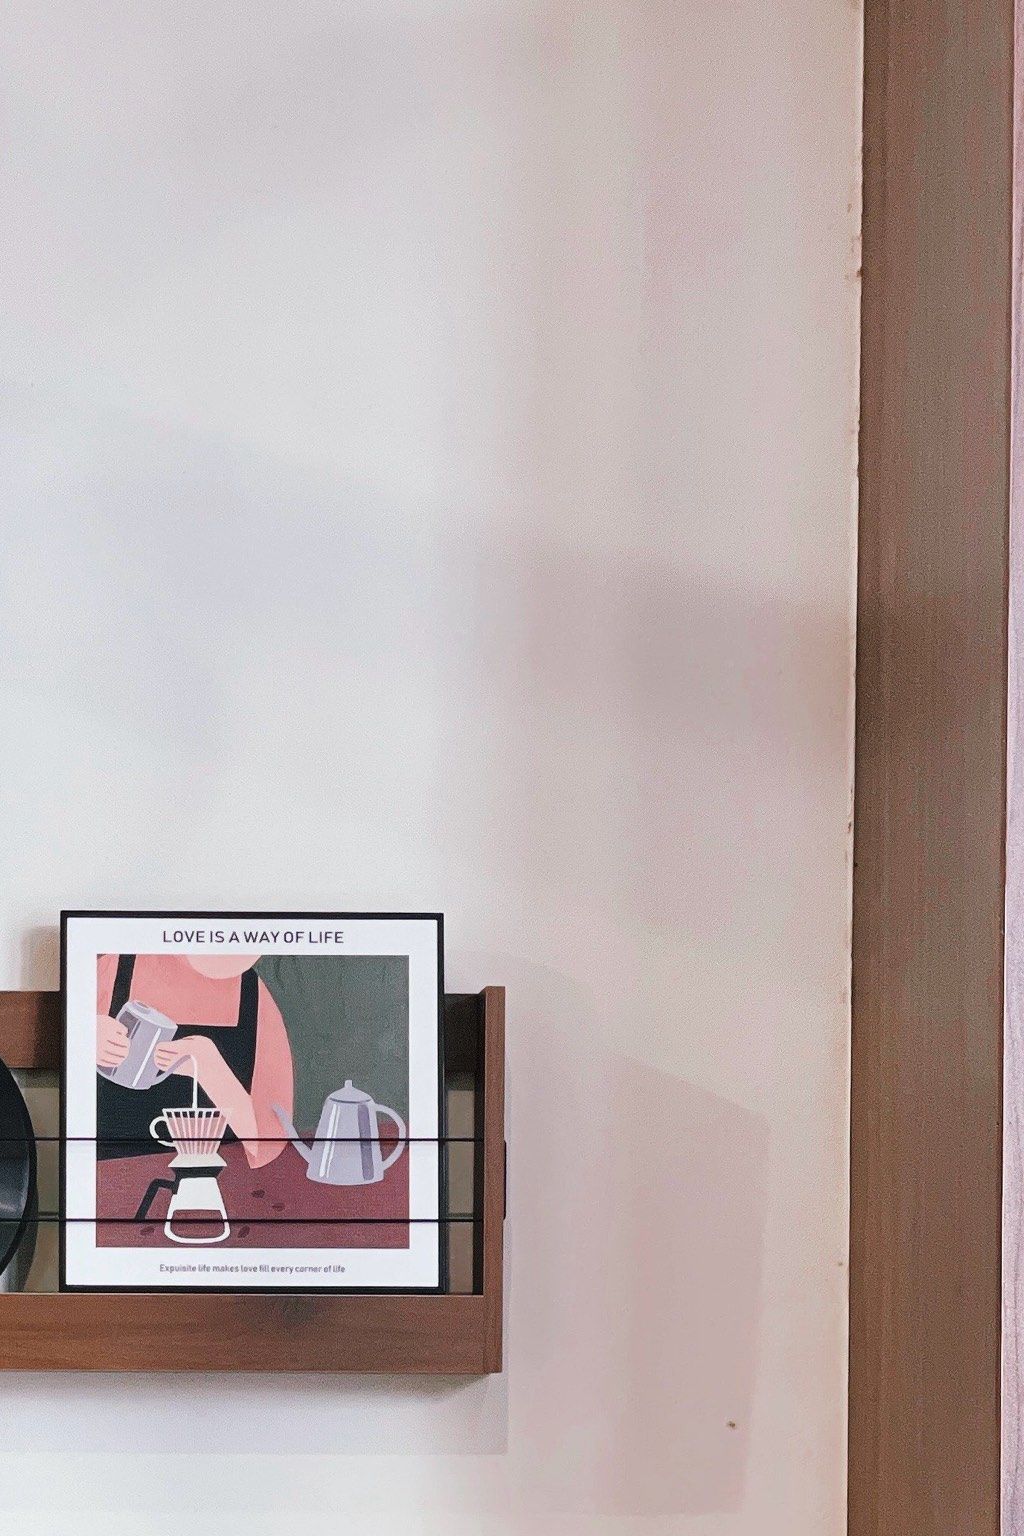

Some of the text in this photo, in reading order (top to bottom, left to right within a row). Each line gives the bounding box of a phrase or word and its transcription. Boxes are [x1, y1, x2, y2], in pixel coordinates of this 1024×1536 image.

[163, 931, 344, 944] LOVE IS A WAY OF LIFE
[198, 1264, 211, 1273] life
[212, 1264, 239, 1273] makes
[240, 1264, 258, 1273] love
[259, 1264, 270, 1273] fill
[271, 1265, 293, 1275] every
[294, 1265, 322, 1273] corner
[323, 1264, 331, 1273] of
[332, 1264, 346, 1273] life
